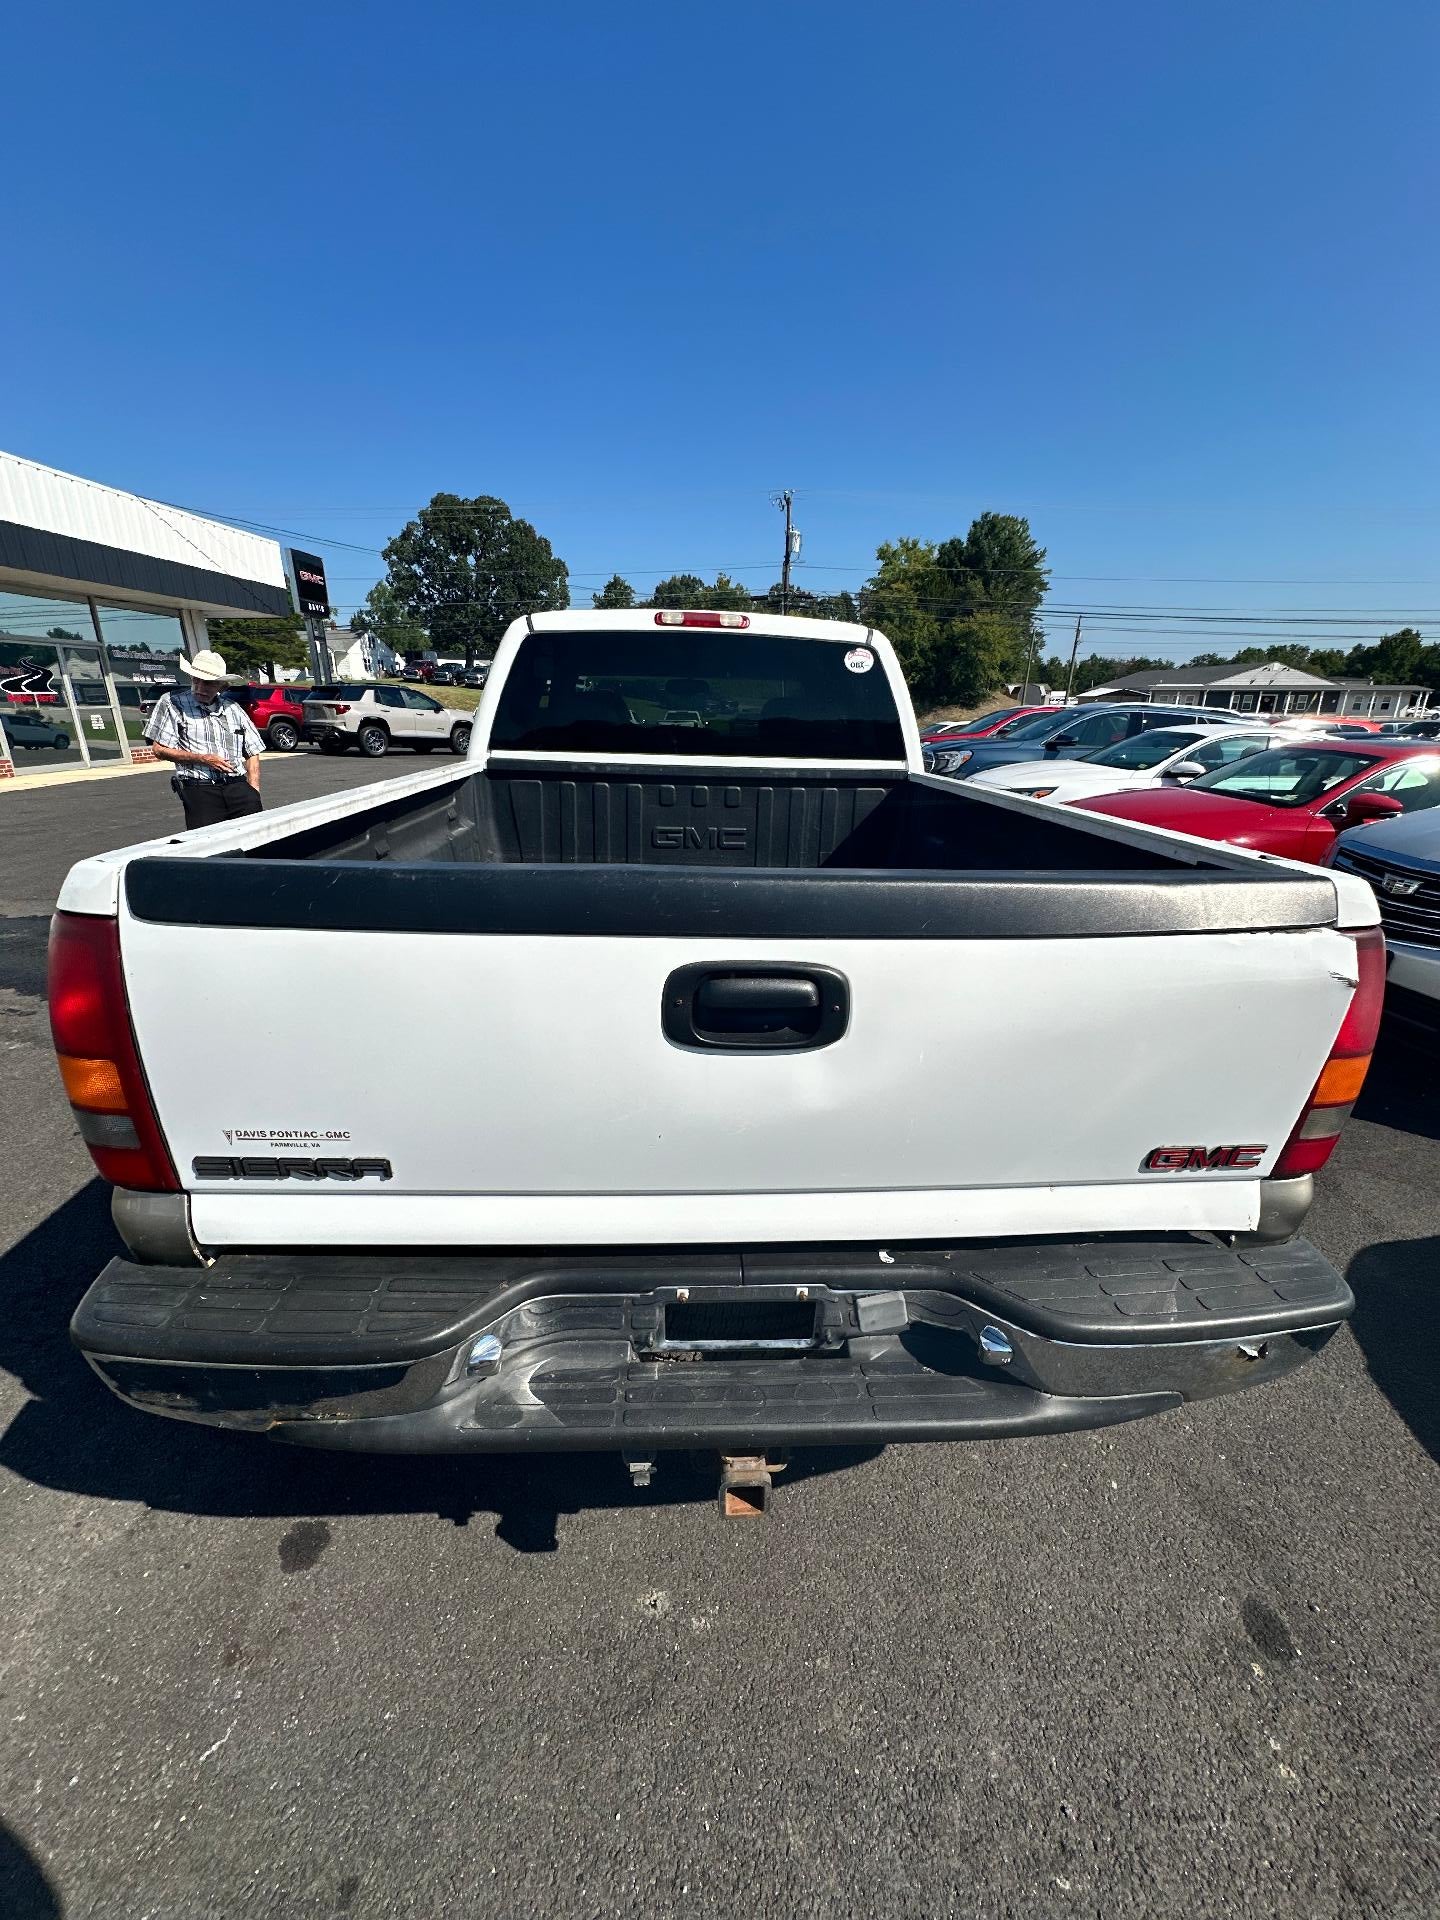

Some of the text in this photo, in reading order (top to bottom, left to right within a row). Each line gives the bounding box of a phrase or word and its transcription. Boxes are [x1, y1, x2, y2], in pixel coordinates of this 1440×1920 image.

[299, 570, 324, 586] GMC
[651, 826, 747, 850] GMC
[235, 1129, 267, 1138] DAVIS
[192, 1155, 393, 1180] SIERRA
[1143, 1144, 1268, 1171] GMC
